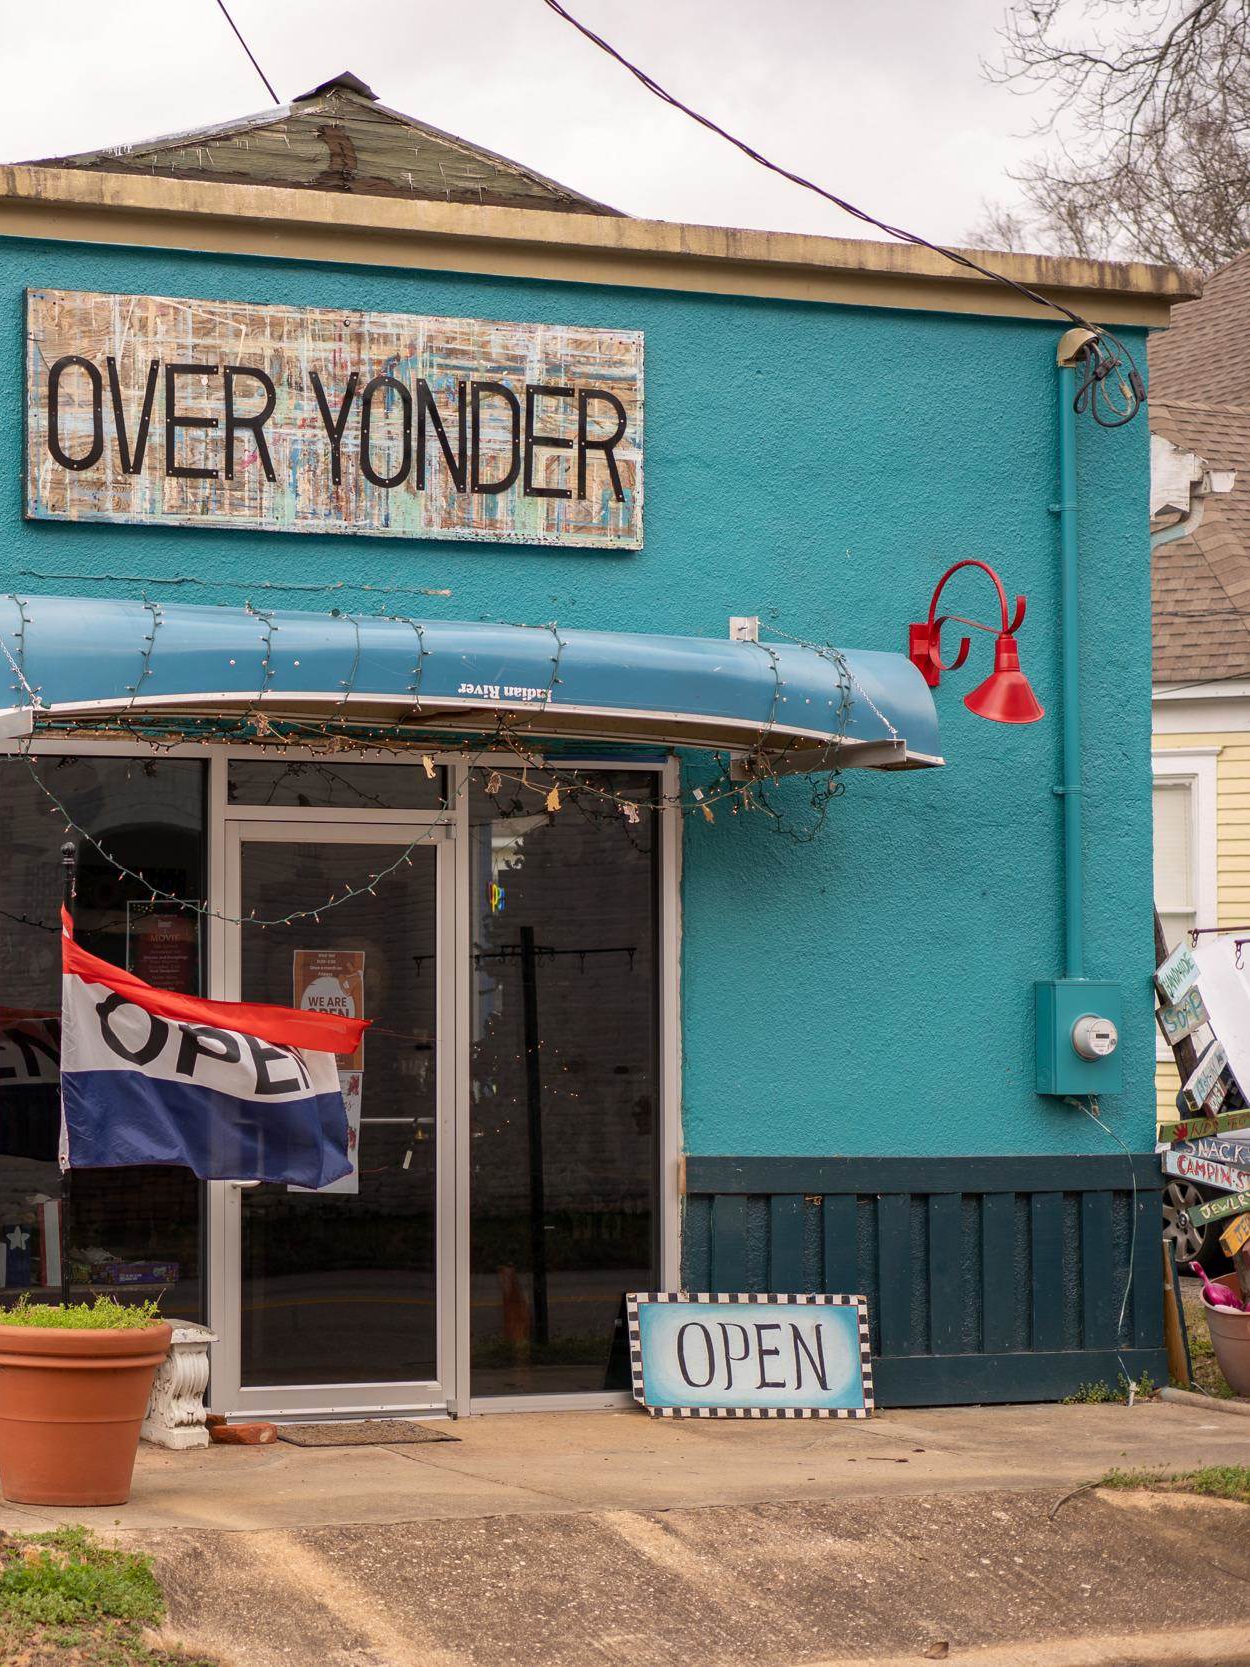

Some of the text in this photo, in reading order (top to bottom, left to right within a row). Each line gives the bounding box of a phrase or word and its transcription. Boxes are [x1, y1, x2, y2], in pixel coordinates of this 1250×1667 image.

[48, 355, 629, 503] OVER YONDER
[457, 683, 553, 703] Indian River
[308, 996, 348, 1007] WE ARE
[676, 1321, 833, 1391] OPEN
